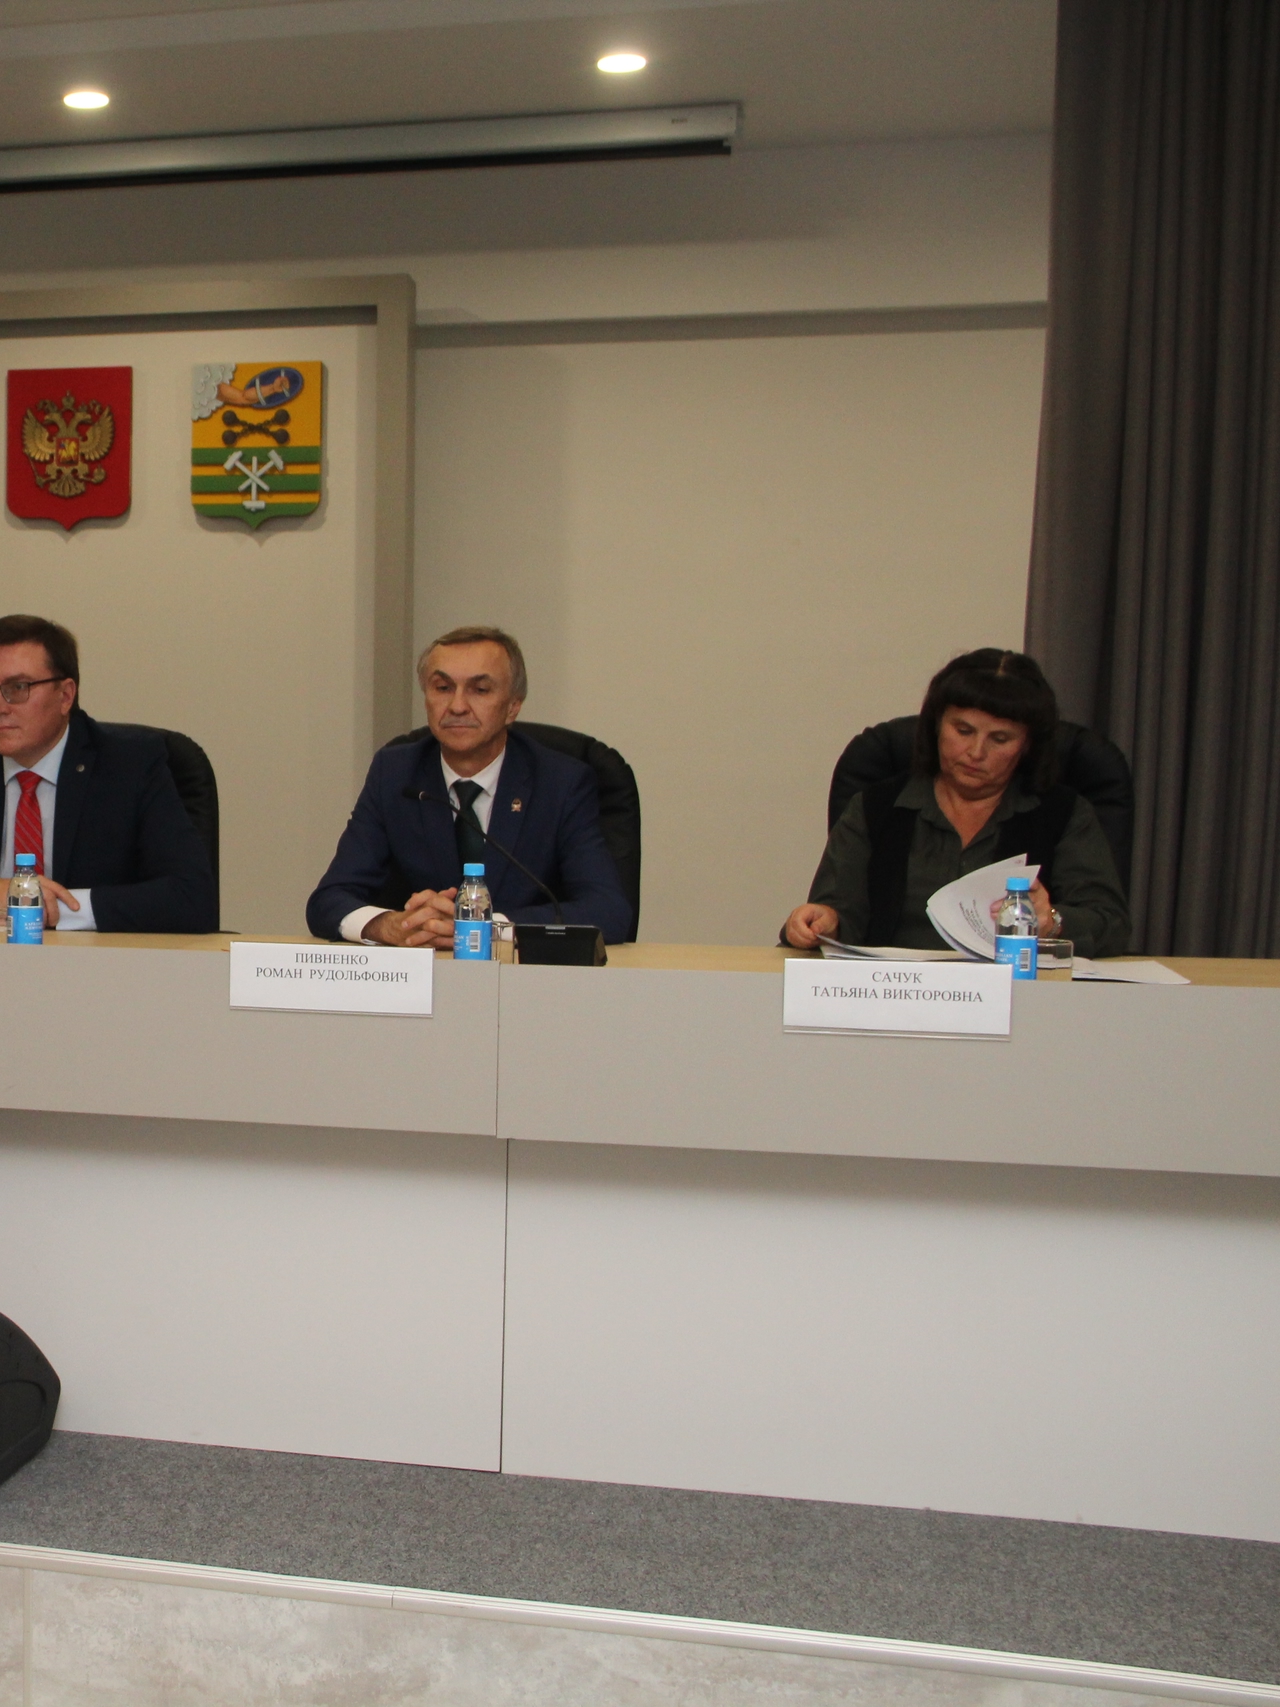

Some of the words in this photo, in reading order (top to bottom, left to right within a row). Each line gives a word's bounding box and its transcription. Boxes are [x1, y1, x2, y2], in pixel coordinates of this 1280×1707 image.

[295, 952, 369, 966] ПИВНЕНКО
[255, 967, 302, 979] РОМАН
[309, 969, 408, 983] РУДОЛЬФОВИЧ
[871, 971, 923, 984] САЧУК
[811, 986, 878, 999] ТАТЬЯНА
[883, 989, 983, 1002] ВИКТОРОВНА
